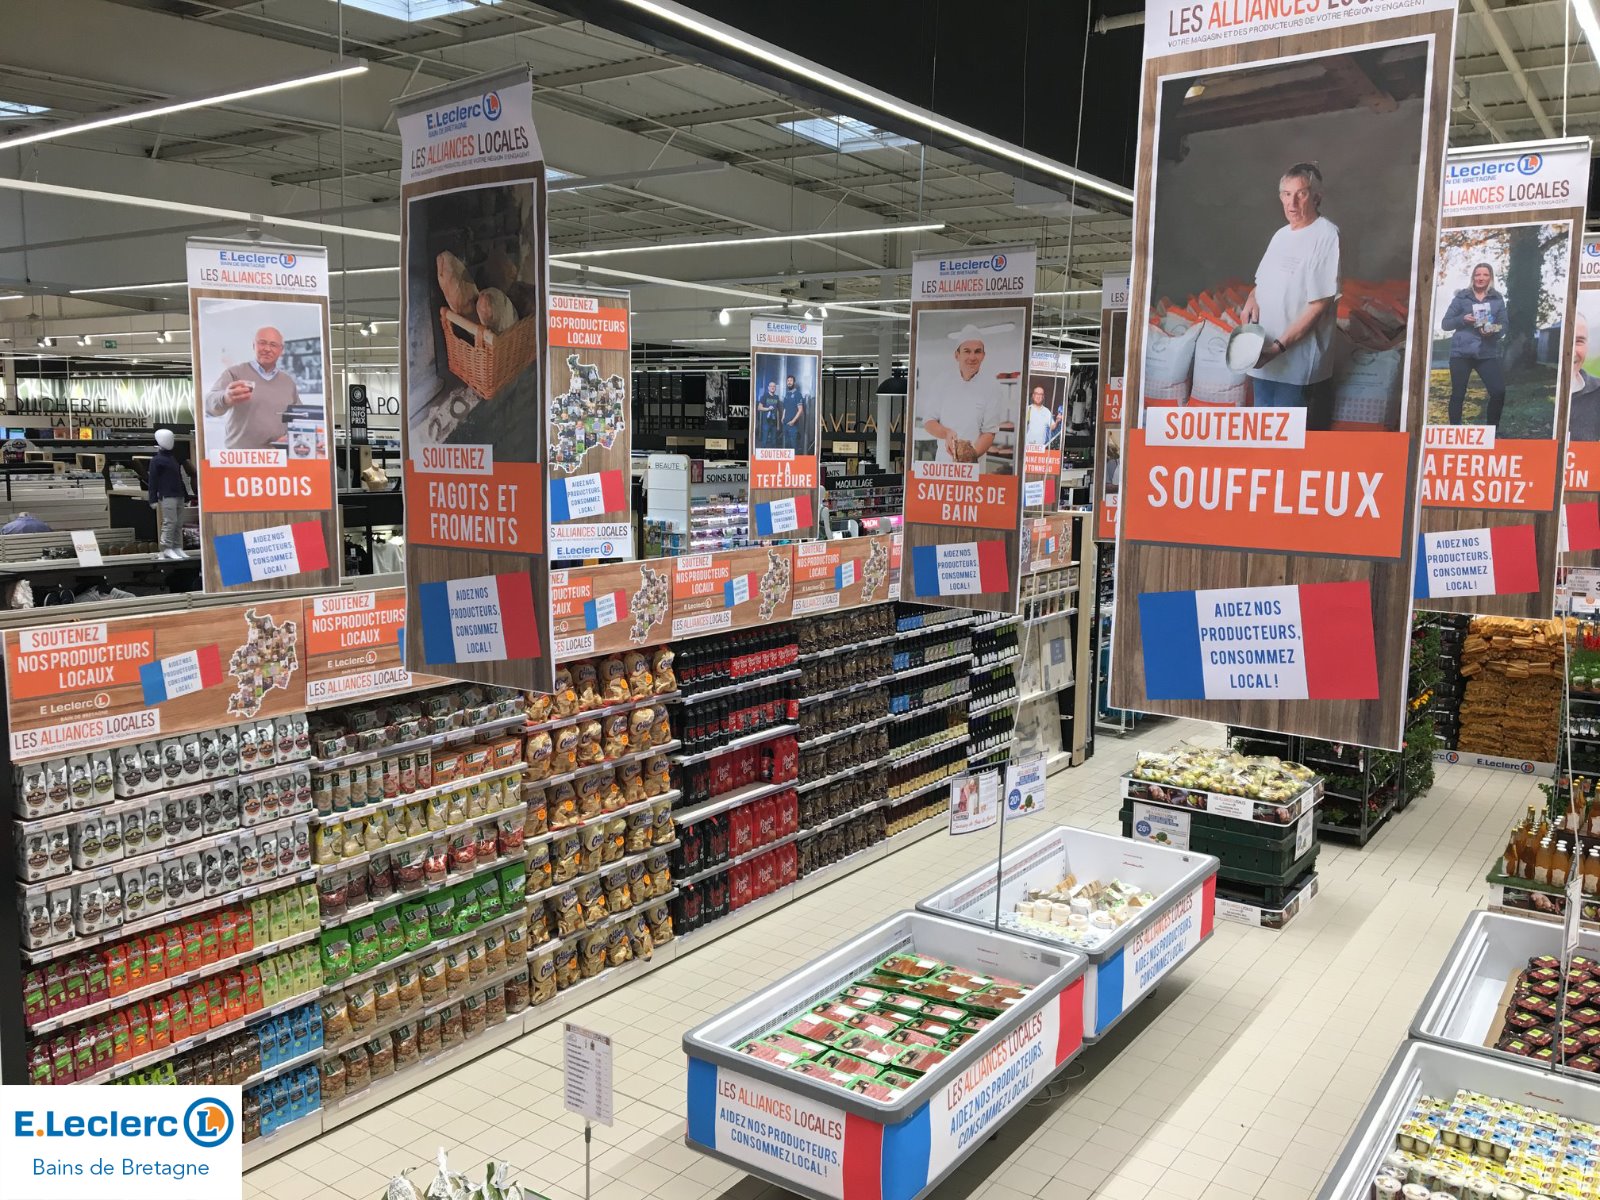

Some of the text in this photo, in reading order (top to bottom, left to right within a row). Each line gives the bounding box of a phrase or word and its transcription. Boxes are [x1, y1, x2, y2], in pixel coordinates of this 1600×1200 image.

[1168, 7, 1204, 37] LES
[1168, 37, 1190, 48] VOTRE
[1190, 32, 1222, 46] MAGASIN
[1233, 28, 1248, 37] DES
[1249, 19, 1304, 35] PRODUCTEURS
[1305, 16, 1315, 25] DE
[1317, 11, 1341, 23] VOTRE
[1343, 6, 1372, 19] RÉGION
[427, 103, 481, 130] E.Leclerc
[411, 147, 426, 169] LES
[427, 135, 475, 166] ALLIANCES
[478, 125, 529, 155] LOCALES
[1443, 180, 1570, 206] LLIANCES LOCALES
[220, 251, 278, 264] E.Leclerc
[940, 260, 990, 271] E.Leclerc
[201, 268, 219, 281] LES
[221, 270, 273, 285] ALLIANCES
[275, 274, 317, 288] LOCALES
[922, 276, 1024, 293] LES ALLIANCES LOCALES
[552, 297, 593, 311] SOUTENEZ
[1111, 292, 1125, 303] LES
[563, 317, 625, 333] PRODUCTEURS
[567, 332, 602, 345] LOCAUX
[51, 417, 148, 428] LA CHARCUTERIE
[1165, 412, 1290, 441] SOUTENEZ
[220, 451, 279, 464] SOUTENEZ
[423, 448, 485, 469] SOUTENEZ
[760, 449, 791, 458] SOUTENEZ
[778, 462, 791, 475] LA
[922, 463, 973, 479] SOUTENEZ
[1442, 454, 1523, 478] FERME
[224, 476, 312, 498] LOBODIS
[706, 474, 726, 483] SOINS
[784, 474, 812, 487] DURE
[835, 479, 873, 488] MAQUILLAGE
[429, 481, 518, 512] FAGOTS ET
[918, 482, 984, 503] SAVEURS
[987, 486, 1006, 505] DE
[1147, 465, 1384, 519] SOUFFLEUX
[942, 504, 977, 522] BAIN
[253, 532, 285, 543] AIDEZ NOS
[430, 513, 518, 545] FROMENTS
[557, 525, 628, 538] ALLIANCES LOCALES
[557, 546, 599, 555] E.Leclerc
[1436, 538, 1479, 549] AIDEZ NOS
[253, 552, 293, 565] CONSOMMEZ
[682, 556, 709, 568] SOUTENEZ
[676, 567, 729, 583] NOS PRODUCTEURS
[941, 571, 977, 580] CONSOMMEZ
[1433, 566, 1488, 578] CONSOMMEZ
[456, 587, 489, 601] AIDEZ NOS
[691, 582, 715, 595] LOCAUX
[322, 595, 370, 612] SOUTENEZ
[1214, 600, 1281, 618] AIDEZ NOS
[312, 609, 405, 633] NOS PRODUCTEURS
[455, 622, 498, 637] CONSOMMEZ
[32, 627, 99, 648] SOUTENEZ
[341, 629, 380, 647] LOCAUX
[1201, 624, 1301, 642] PRODUCTEURS,
[566, 636, 592, 650] LOCALES
[17, 641, 150, 674] NOS PRODUCTEURS
[1210, 649, 1295, 665] CONSOMMEZ
[59, 666, 115, 689] LOCAUX
[309, 682, 325, 697] LES
[328, 675, 372, 695] ALLIANCES
[373, 670, 409, 686] LOCALES
[14, 732, 38, 750] LES
[41, 722, 103, 746] ALLIANCES
[106, 712, 155, 734] LOCALES
[1477, 758, 1520, 770] E.Leclerc
[1133, 933, 1143, 955] LES
[947, 1011, 1042, 1111] LES ALLIANCES LOCALES
[718, 1079, 842, 1141] LES ALLIANCES LOCALES
[950, 1101, 974, 1136] AIDEZ
[974, 1088, 990, 1117] NOS
[719, 1107, 747, 1131] AIDEZ
[747, 1116, 767, 1137] NOS
[958, 1094, 1007, 1149] CONSOMMEZ
[730, 1128, 790, 1163] CONSOMMEZ
